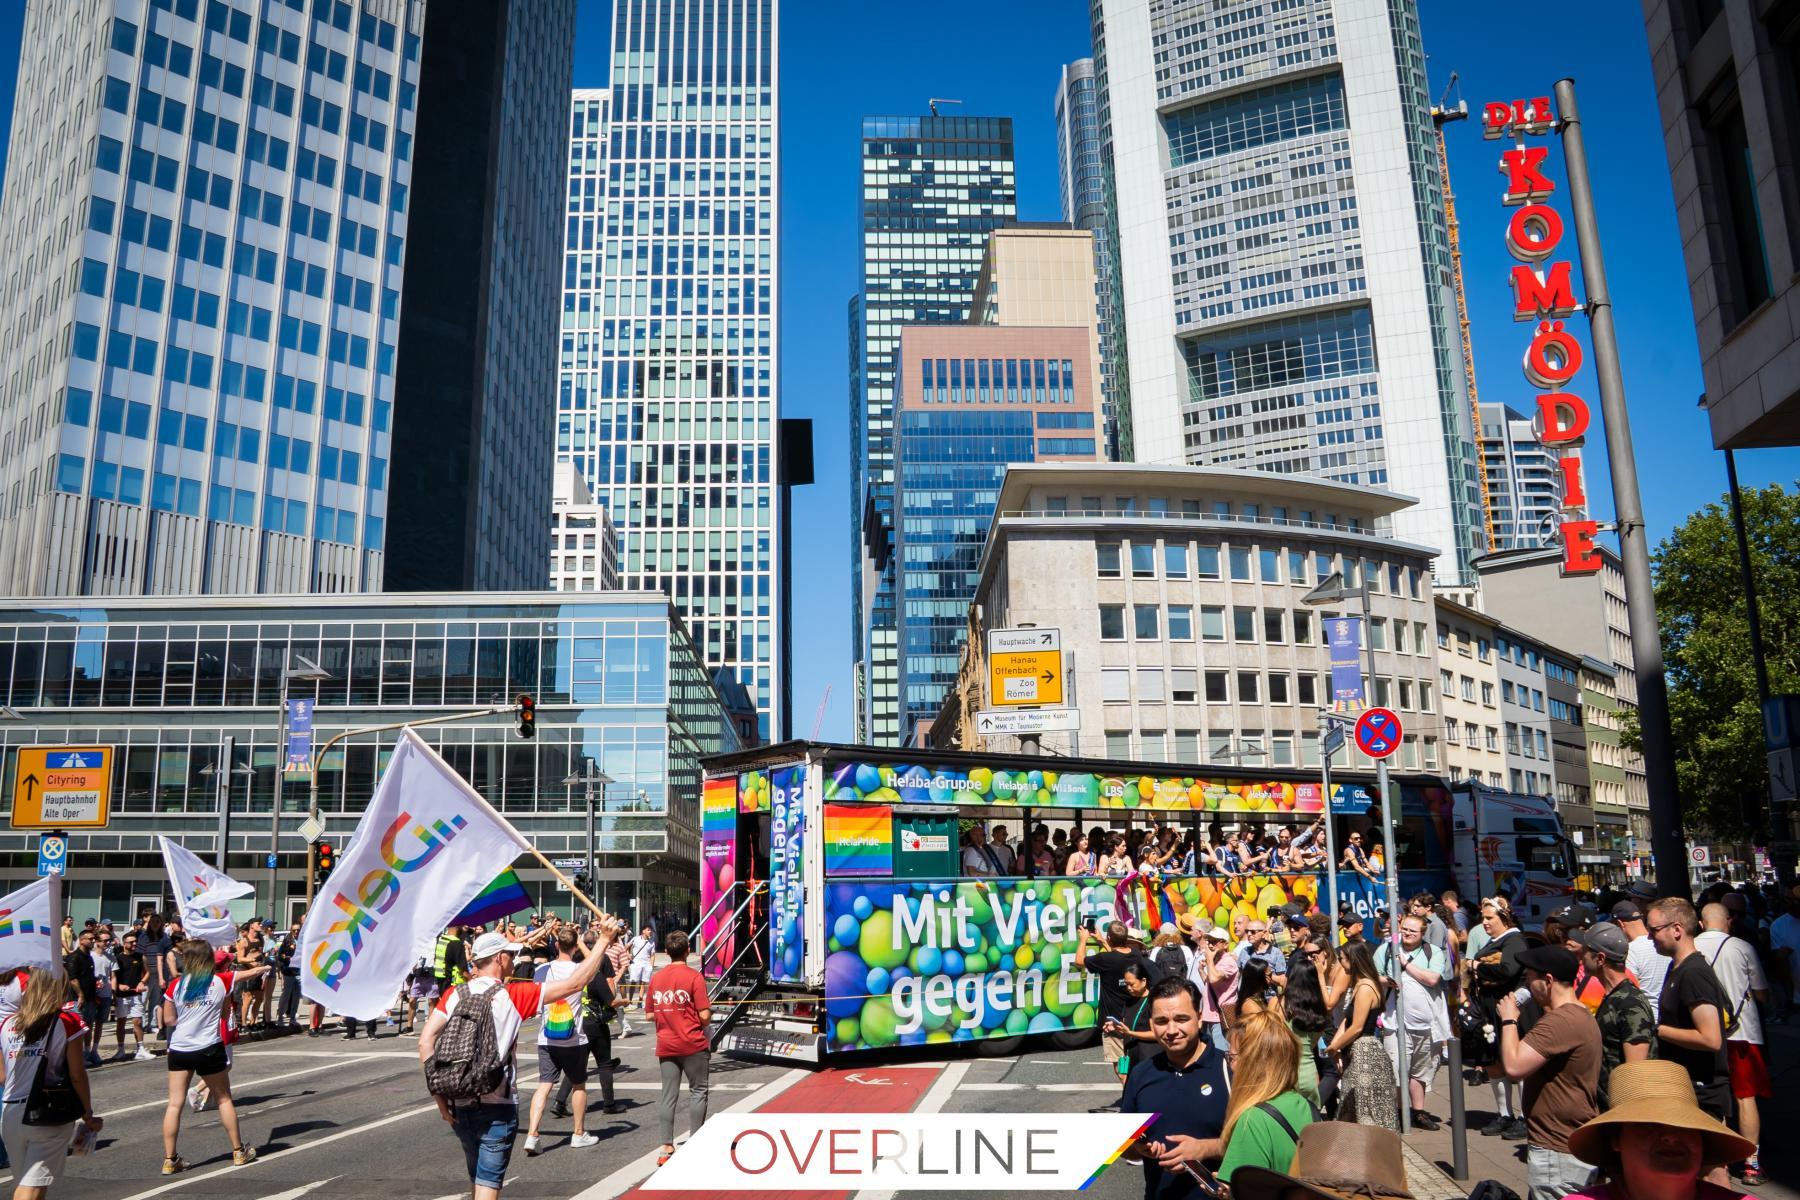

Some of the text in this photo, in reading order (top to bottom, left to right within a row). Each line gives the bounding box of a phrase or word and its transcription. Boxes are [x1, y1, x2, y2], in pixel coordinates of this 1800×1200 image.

[1485, 97, 1553, 128] DIE
[1503, 147, 1602, 572] KOMÖDIE
[998, 637, 1036, 648] Hauptwache
[1010, 656, 1037, 664] Hanau
[995, 666, 1038, 676] Offenbach
[1019, 680, 1035, 688] Zoo
[1006, 689, 1035, 698] Römer
[1053, 712, 1068, 720] Kunst
[47, 774, 87, 787] Cityring
[887, 774, 983, 791] Helaba-Gruppe
[1104, 785, 1124, 797] LBS
[1297, 788, 1313, 797] OFB
[45, 794, 97, 806] Hauptbahnhof
[44, 808, 80, 820] Alte Oper
[772, 788, 786, 863] gegen
[787, 787, 801, 921] Mit Vielfalt
[41, 862, 63, 872] TAXI
[892, 888, 1148, 950] Mit Vielfat
[891, 968, 1043, 1035] gegen
